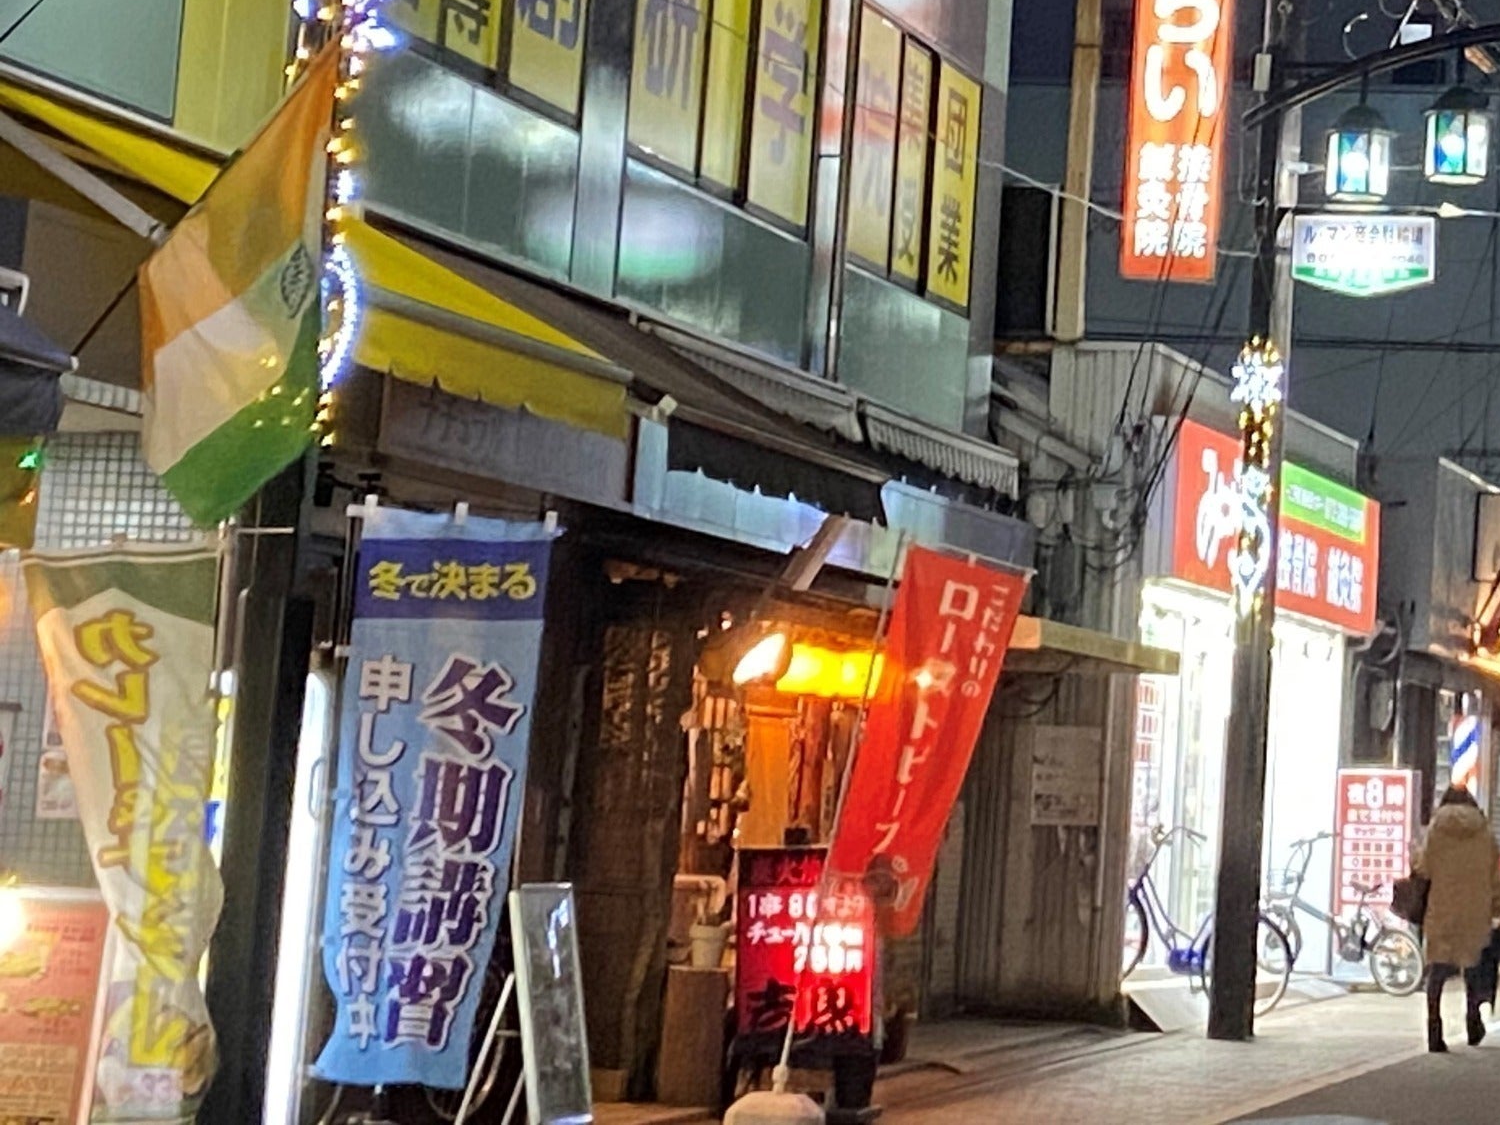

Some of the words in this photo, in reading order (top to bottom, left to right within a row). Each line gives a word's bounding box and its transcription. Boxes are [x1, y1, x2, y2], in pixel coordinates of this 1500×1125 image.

[1134, 142, 1176, 258] 鍼灸院
[1173, 143, 1212, 258] 接骨院
[368, 559, 538, 603] 冬で決まる
[960, 582, 1011, 699] こだわりの
[338, 654, 415, 1051] 申し込み受付中
[384, 653, 524, 1052] 冬期講習
